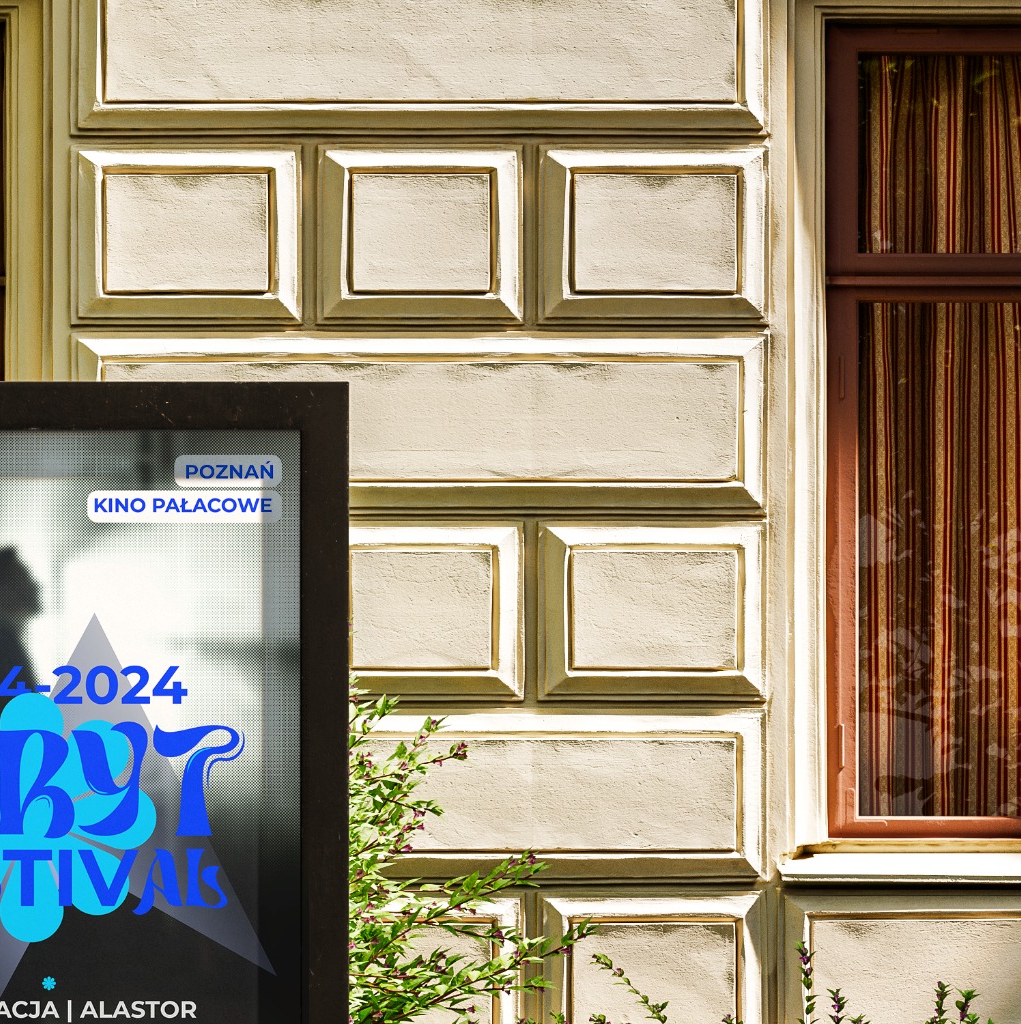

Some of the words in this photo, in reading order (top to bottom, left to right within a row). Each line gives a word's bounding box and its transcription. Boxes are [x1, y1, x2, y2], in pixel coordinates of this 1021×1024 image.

[185, 460, 274, 479] POZNAŃ
[94, 497, 146, 513] KINO
[152, 497, 272, 513] PAŁACOWE
[80, 1000, 197, 1019] ALASTOR
